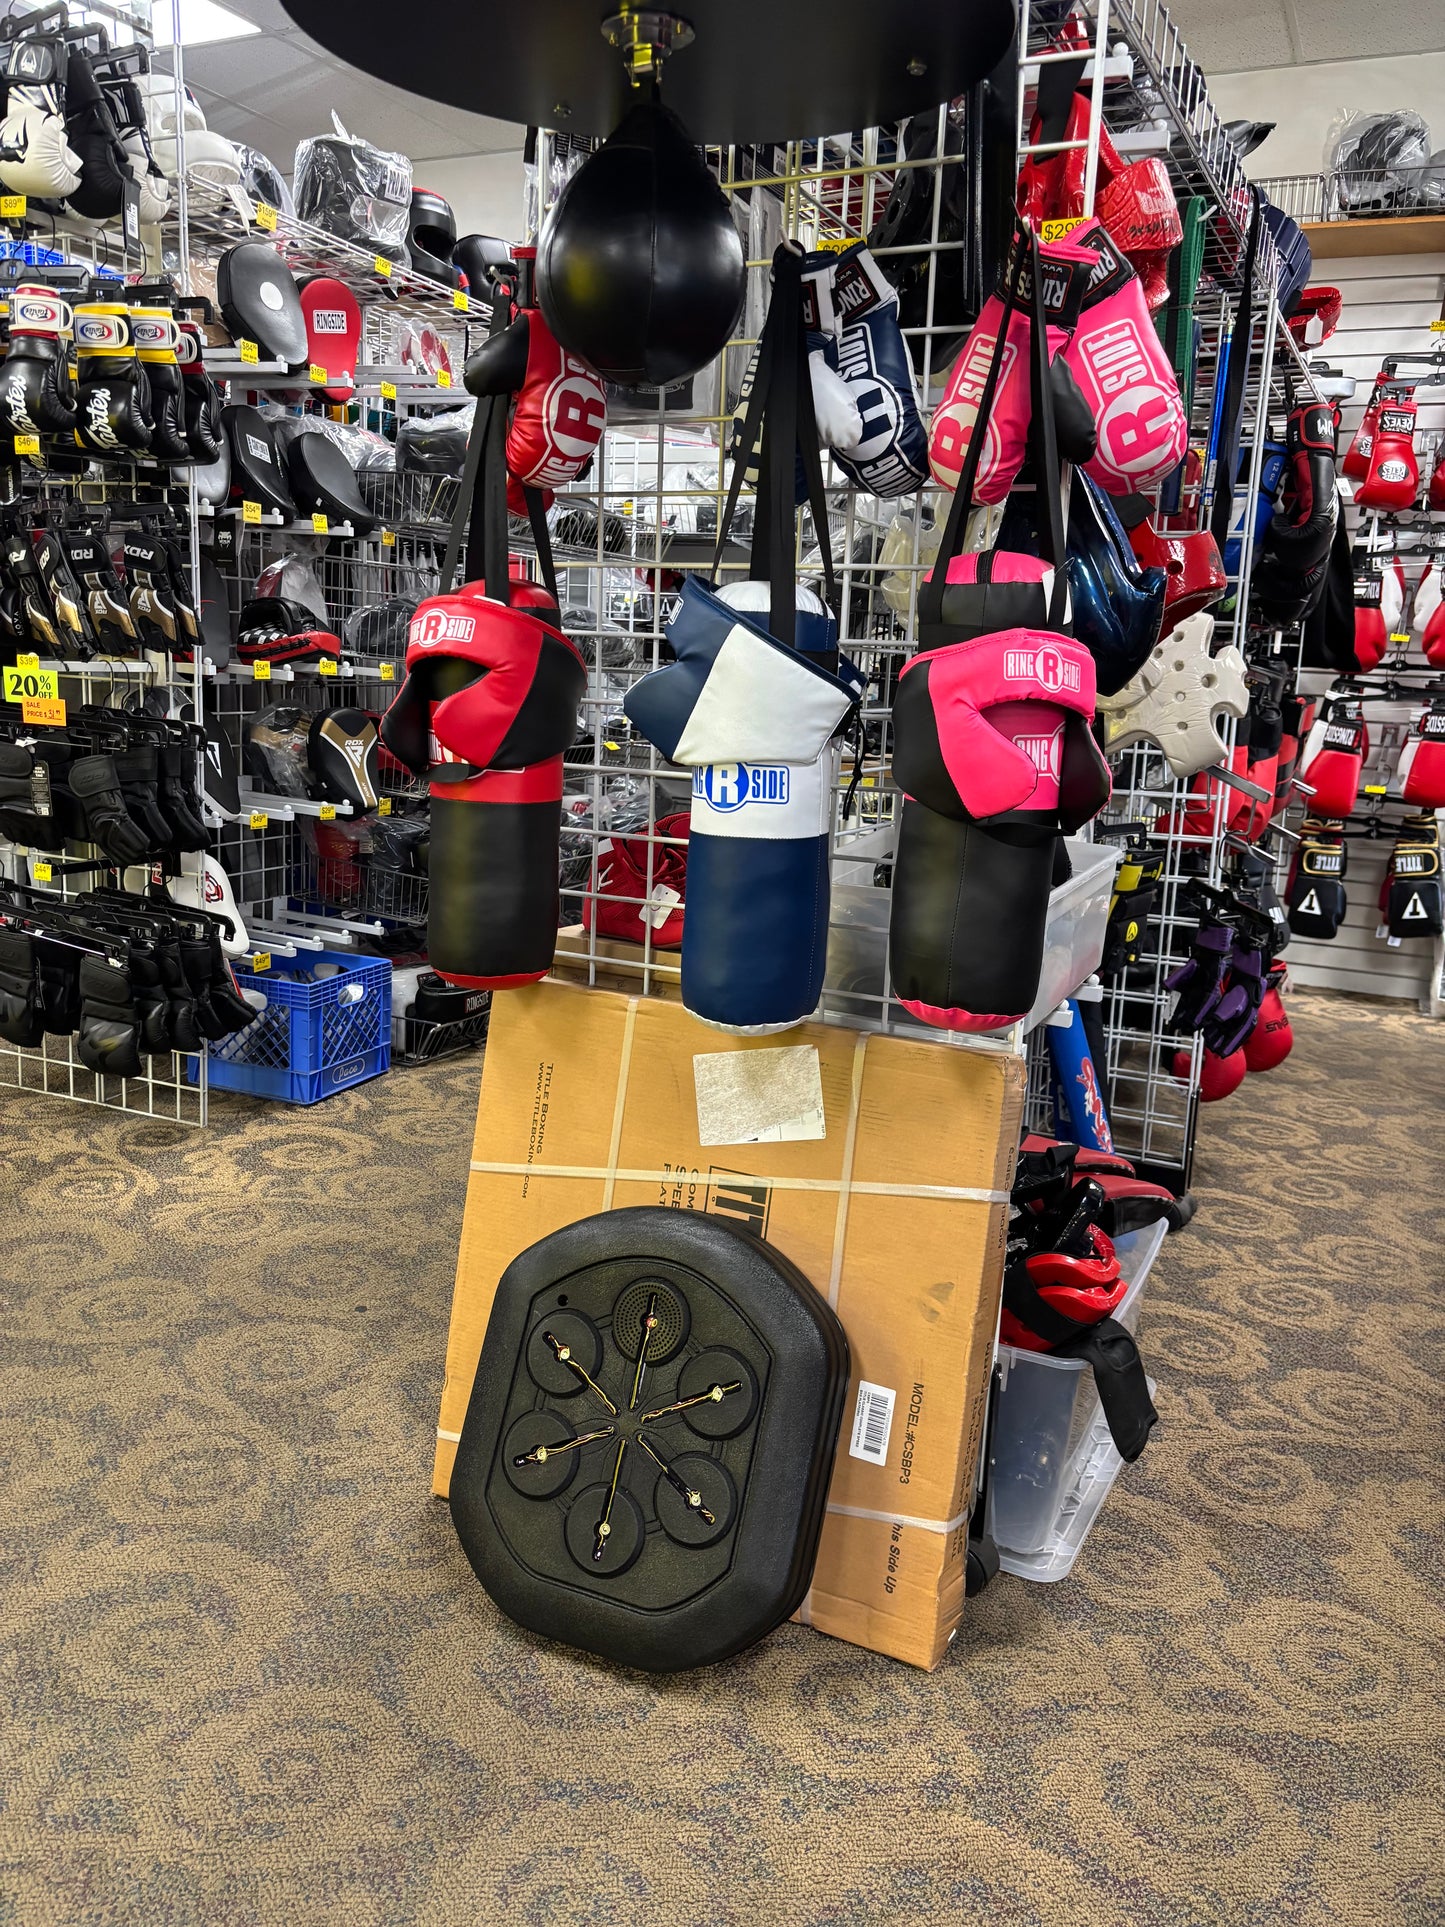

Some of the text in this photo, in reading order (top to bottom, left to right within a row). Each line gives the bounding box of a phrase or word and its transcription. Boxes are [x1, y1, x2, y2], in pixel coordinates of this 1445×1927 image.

[316, 313, 346, 332] RINGSIDE
[1086, 326, 1148, 395] SIDE
[86, 388, 124, 449] Fairtex
[553, 388, 606, 445] R
[1382, 414, 1413, 430] REYES
[1382, 465, 1408, 476] REYES
[424, 615, 442, 642] R
[446, 618, 473, 640] SIDE
[1007, 651, 1080, 689] RING R SIDE
[38, 691, 53, 699] OFF
[26, 710, 43, 718] PRICE
[344, 739, 364, 747] RDX
[711, 764, 740, 804] R
[752, 769, 786, 800] SIDE
[1315, 856, 1340, 871] TITLE
[1396, 856, 1423, 872] TITLE
[536, 1062, 554, 1155] TITLE BOXING
[889, 1544, 901, 1572] Side
[885, 1575, 898, 1594] Up
